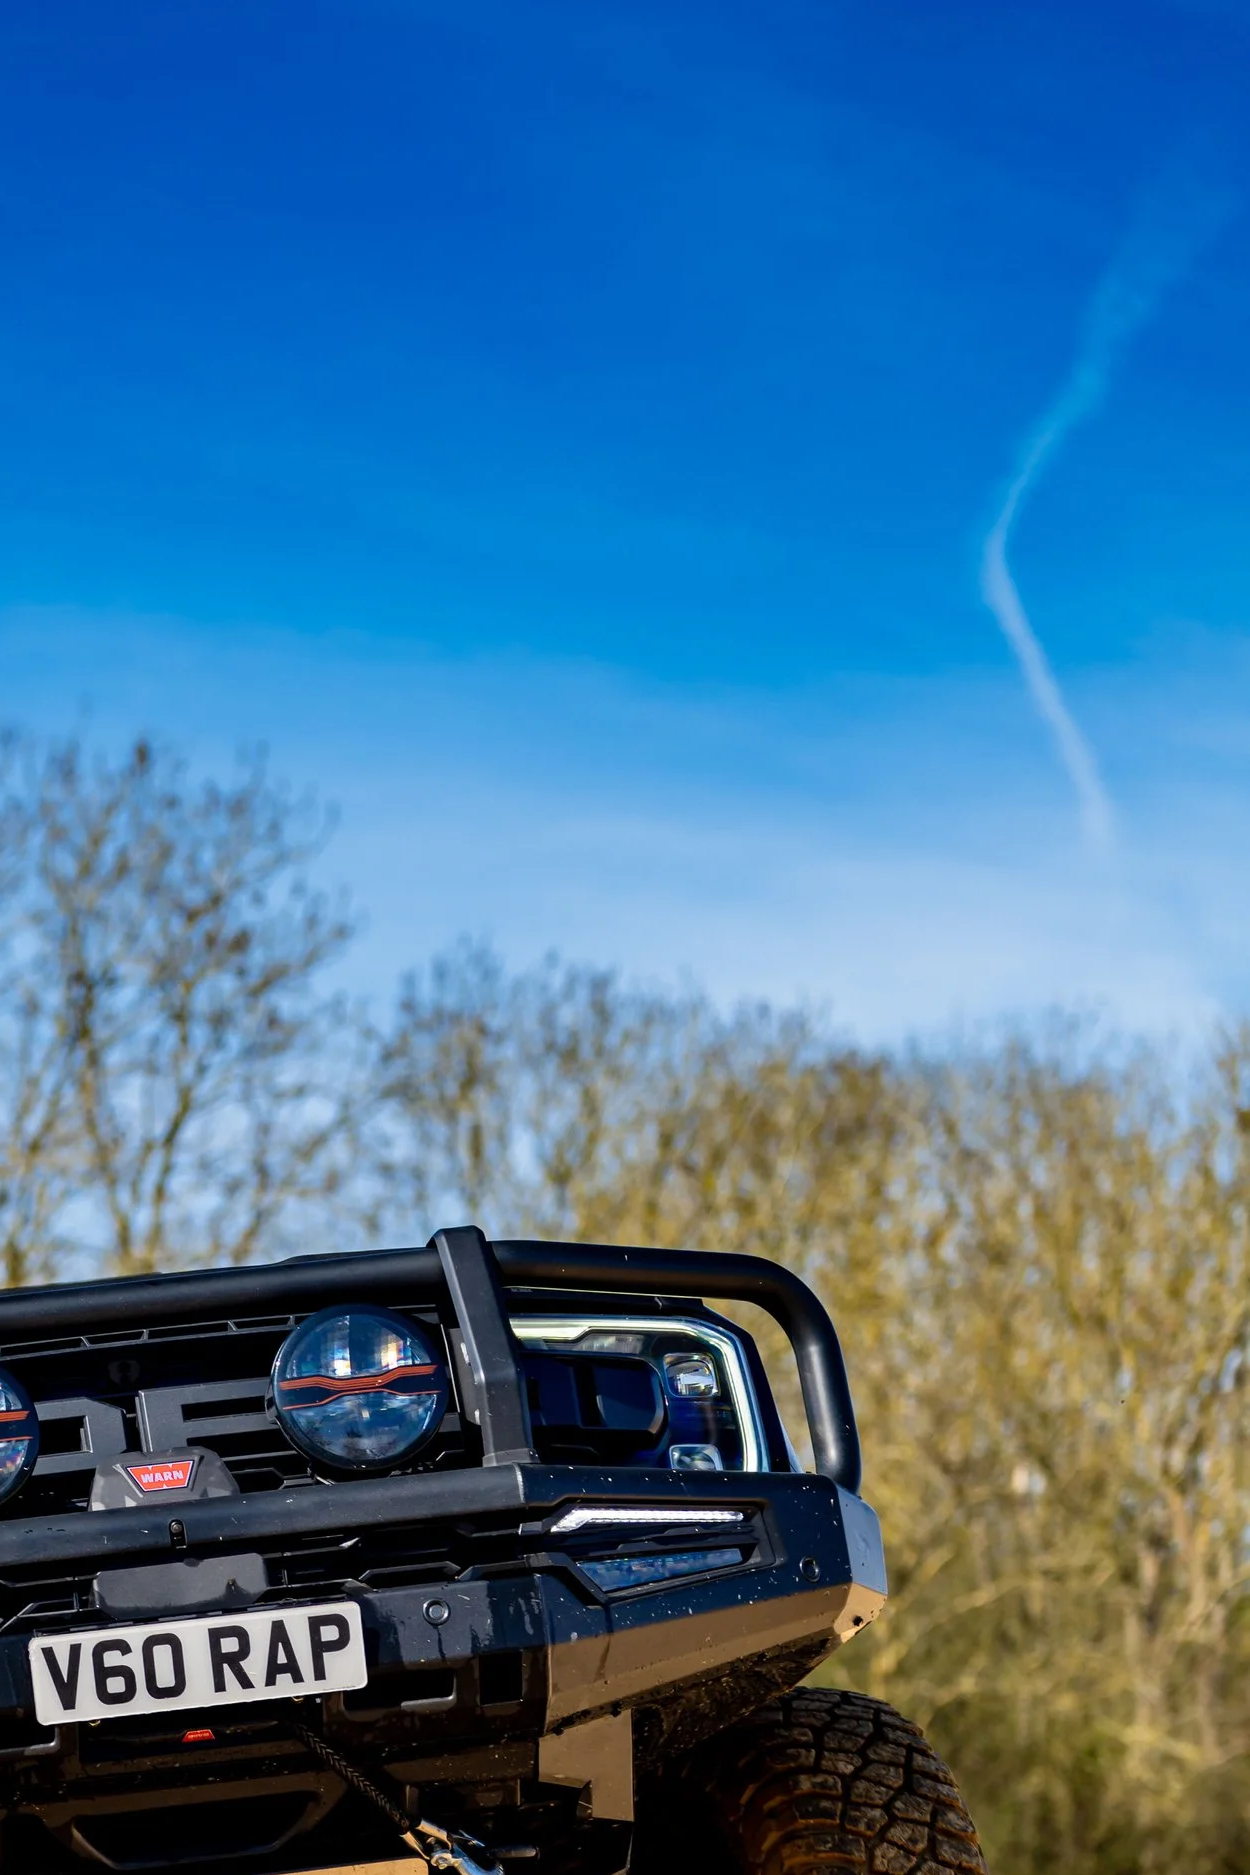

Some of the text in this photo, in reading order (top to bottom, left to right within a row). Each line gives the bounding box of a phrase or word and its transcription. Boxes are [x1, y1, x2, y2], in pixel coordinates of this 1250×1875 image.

[140, 1469, 184, 1484] WARN
[40, 1613, 351, 1711] V60 RAP
